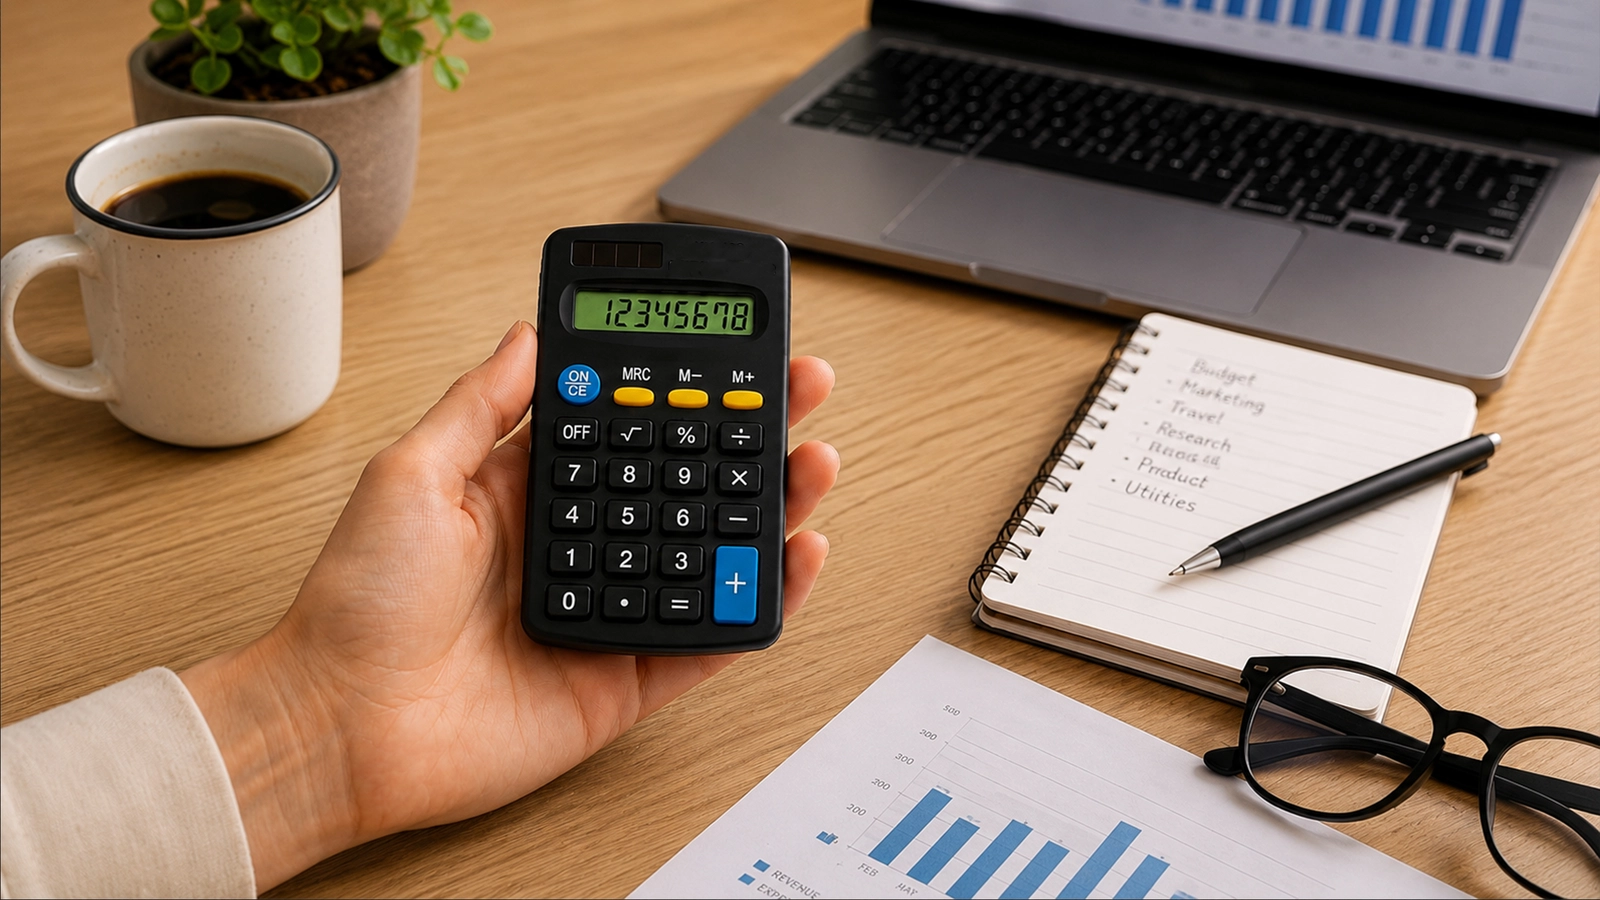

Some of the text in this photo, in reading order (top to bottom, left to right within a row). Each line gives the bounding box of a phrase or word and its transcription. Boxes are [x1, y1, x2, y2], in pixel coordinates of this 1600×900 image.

[604, 298, 749, 331] 12345678
[568, 370, 589, 383] ON
[622, 367, 651, 381] MRC
[732, 370, 755, 383] M+
[1191, 358, 1257, 386] Budget
[568, 384, 587, 397] CE
[1179, 378, 1266, 416] Marketing
[1171, 399, 1225, 425] Travel
[562, 424, 591, 440] OFF
[677, 427, 696, 444] %
[1155, 420, 1232, 453] Research
[568, 464, 581, 482] 7
[622, 465, 636, 483] 8
[678, 467, 691, 485] 9
[565, 505, 579, 524] 4
[621, 506, 635, 525] 5
[676, 508, 690, 527] 6
[565, 548, 575, 567] 1
[619, 550, 633, 568] 2
[675, 552, 688, 570] 3
[562, 591, 576, 610] 0
[942, 704, 961, 717] 500
[894, 752, 915, 766] 300
[857, 863, 879, 877] FEB
[771, 869, 821, 899] REVENUE
